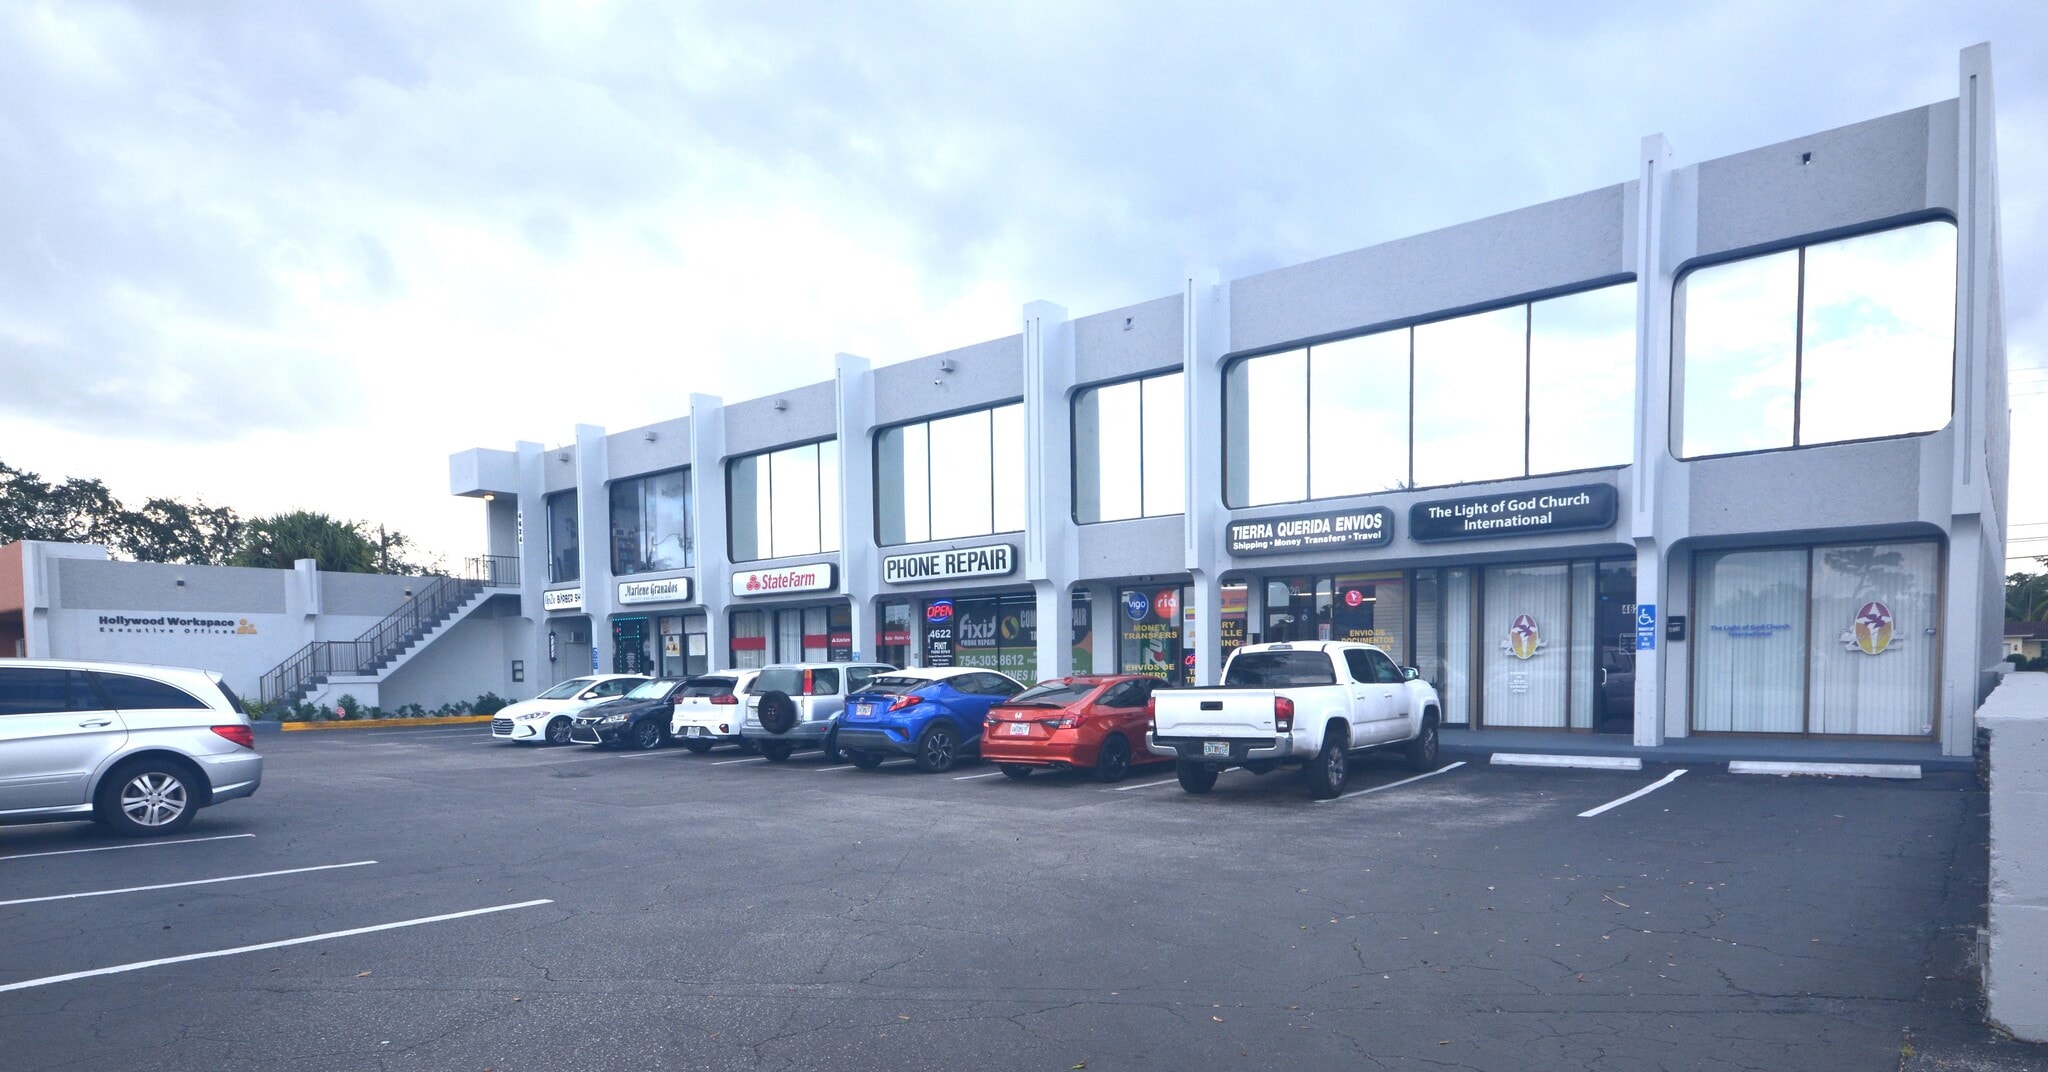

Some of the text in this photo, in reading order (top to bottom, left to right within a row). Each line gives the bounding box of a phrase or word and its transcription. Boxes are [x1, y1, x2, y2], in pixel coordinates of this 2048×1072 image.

[1428, 492, 1590, 519] The Light of God Church
[1232, 513, 1383, 540] TIERRA QUERIDA ENVIOS
[1464, 512, 1552, 531] International
[1233, 531, 1381, 551] Shipping Money Transfers Travel
[887, 548, 1007, 579] PHONE REPAIR
[624, 581, 678, 597] Marlene Granados
[1128, 600, 1146, 610] vigo
[1157, 594, 1177, 608] ria
[927, 605, 953, 618] OPEN
[1020, 609, 1037, 628] COM
[99, 615, 235, 628] Hollywood Workspace
[929, 629, 952, 639] 4622
[1349, 629, 1374, 637] ENVIO
[1163, 663, 1175, 671] DE
